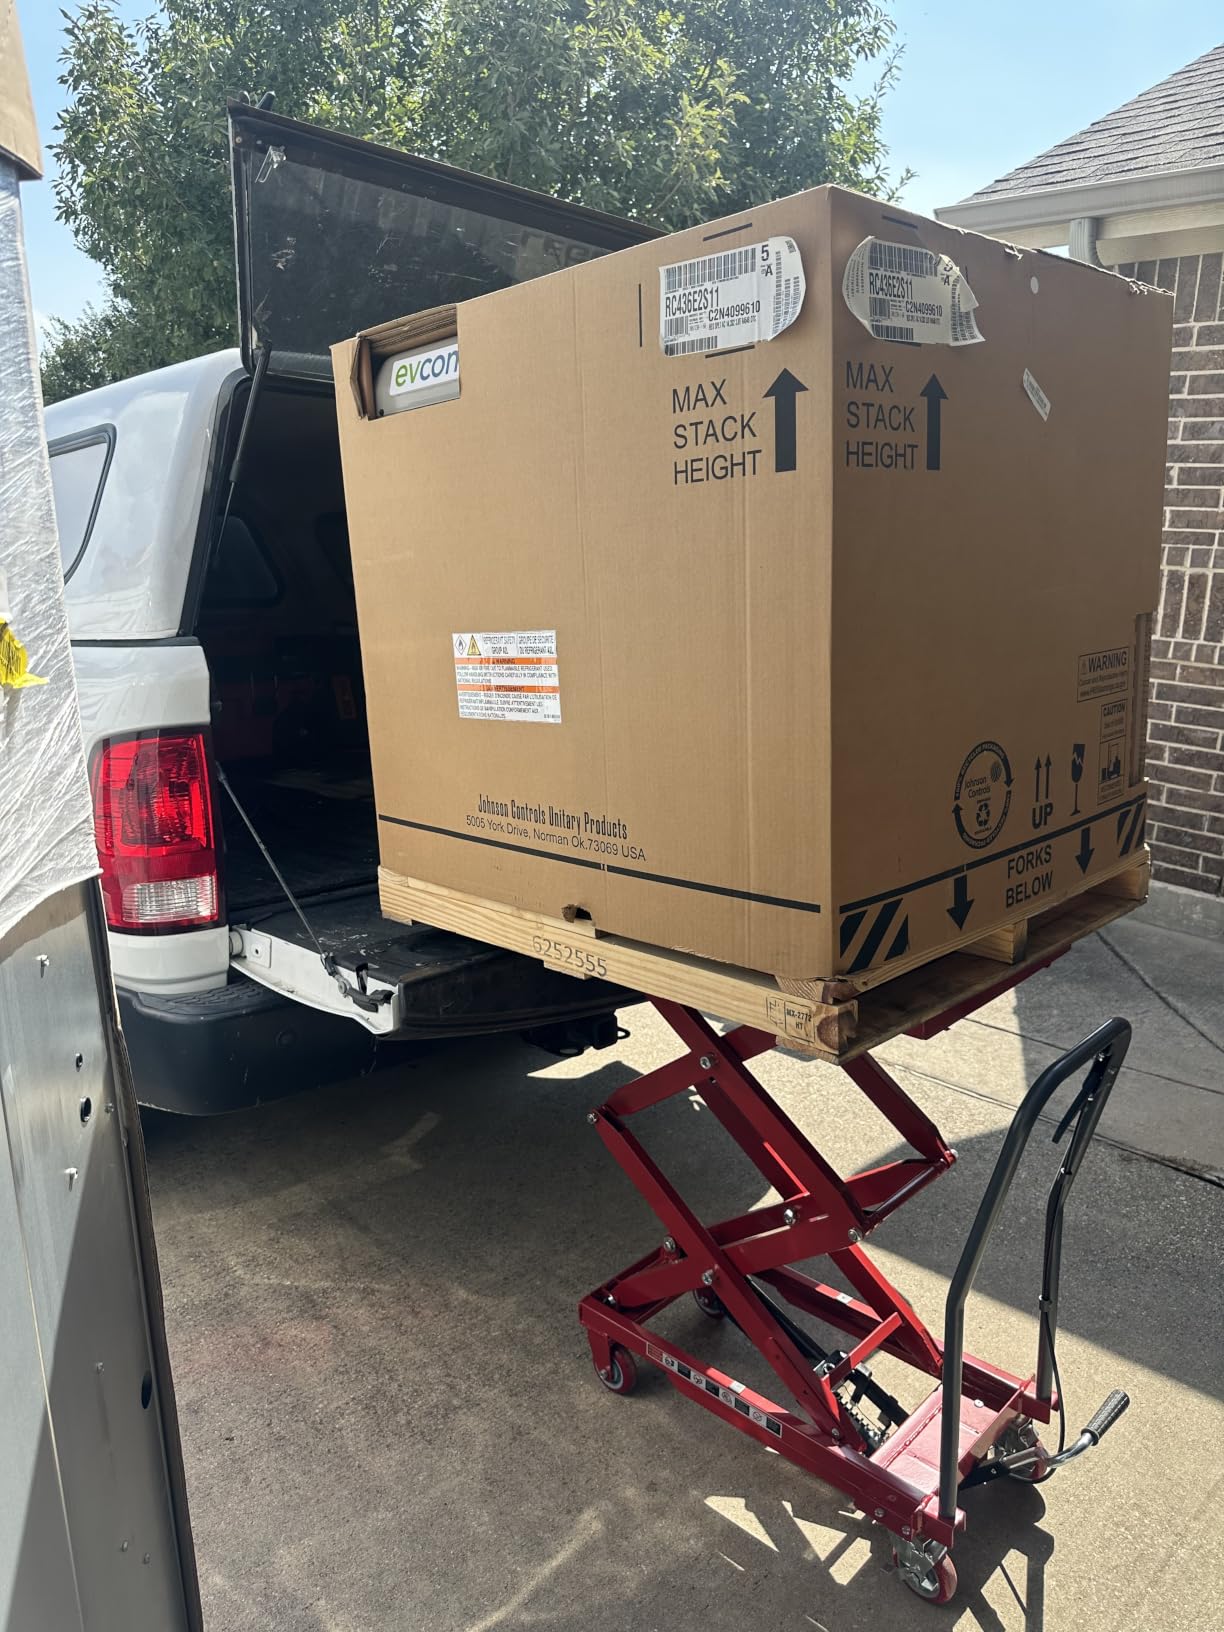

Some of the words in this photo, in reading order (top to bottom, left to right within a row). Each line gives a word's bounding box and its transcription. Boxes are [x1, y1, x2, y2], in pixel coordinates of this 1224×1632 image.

[761, 244, 770, 261] 5
[764, 265, 773, 277] A
[943, 275, 950, 286] A
[869, 272, 913, 300] RC436E2S11
[665, 286, 719, 318] RC436E2S11
[708, 300, 761, 322] C2N4099610
[905, 301, 943, 317] C2N4099610
[395, 350, 459, 388] evcon
[846, 361, 894, 393] MAX
[672, 378, 727, 414] MAX
[673, 411, 757, 449] STACK
[846, 401, 915, 432] STACK
[674, 449, 762, 485] HEIGHT
[846, 440, 919, 471] HEIGHT
[1088, 651, 1127, 673] WARNING
[1103, 702, 1125, 717] CAUTION
[965, 776, 987, 791] Johnson
[968, 784, 991, 799] Controls
[478, 794, 509, 817] Johnson
[511, 800, 546, 825] Controls
[549, 806, 581, 835] Unitary
[584, 812, 628, 840] Products
[1032, 803, 1053, 829] UP
[466, 815, 486, 829] 5005
[487, 818, 504, 833] York
[507, 824, 531, 840] Drive,
[533, 828, 569, 846] Norman
[571, 835, 618, 856] Ok.73069
[621, 845, 646, 861] USA
[1007, 845, 1052, 879] FORKS
[1006, 871, 1053, 908] BELOW
[532, 935, 607, 977] 6252555
[786, 1008, 812, 1022] MX-2772
[796, 1021, 803, 1030] HT
